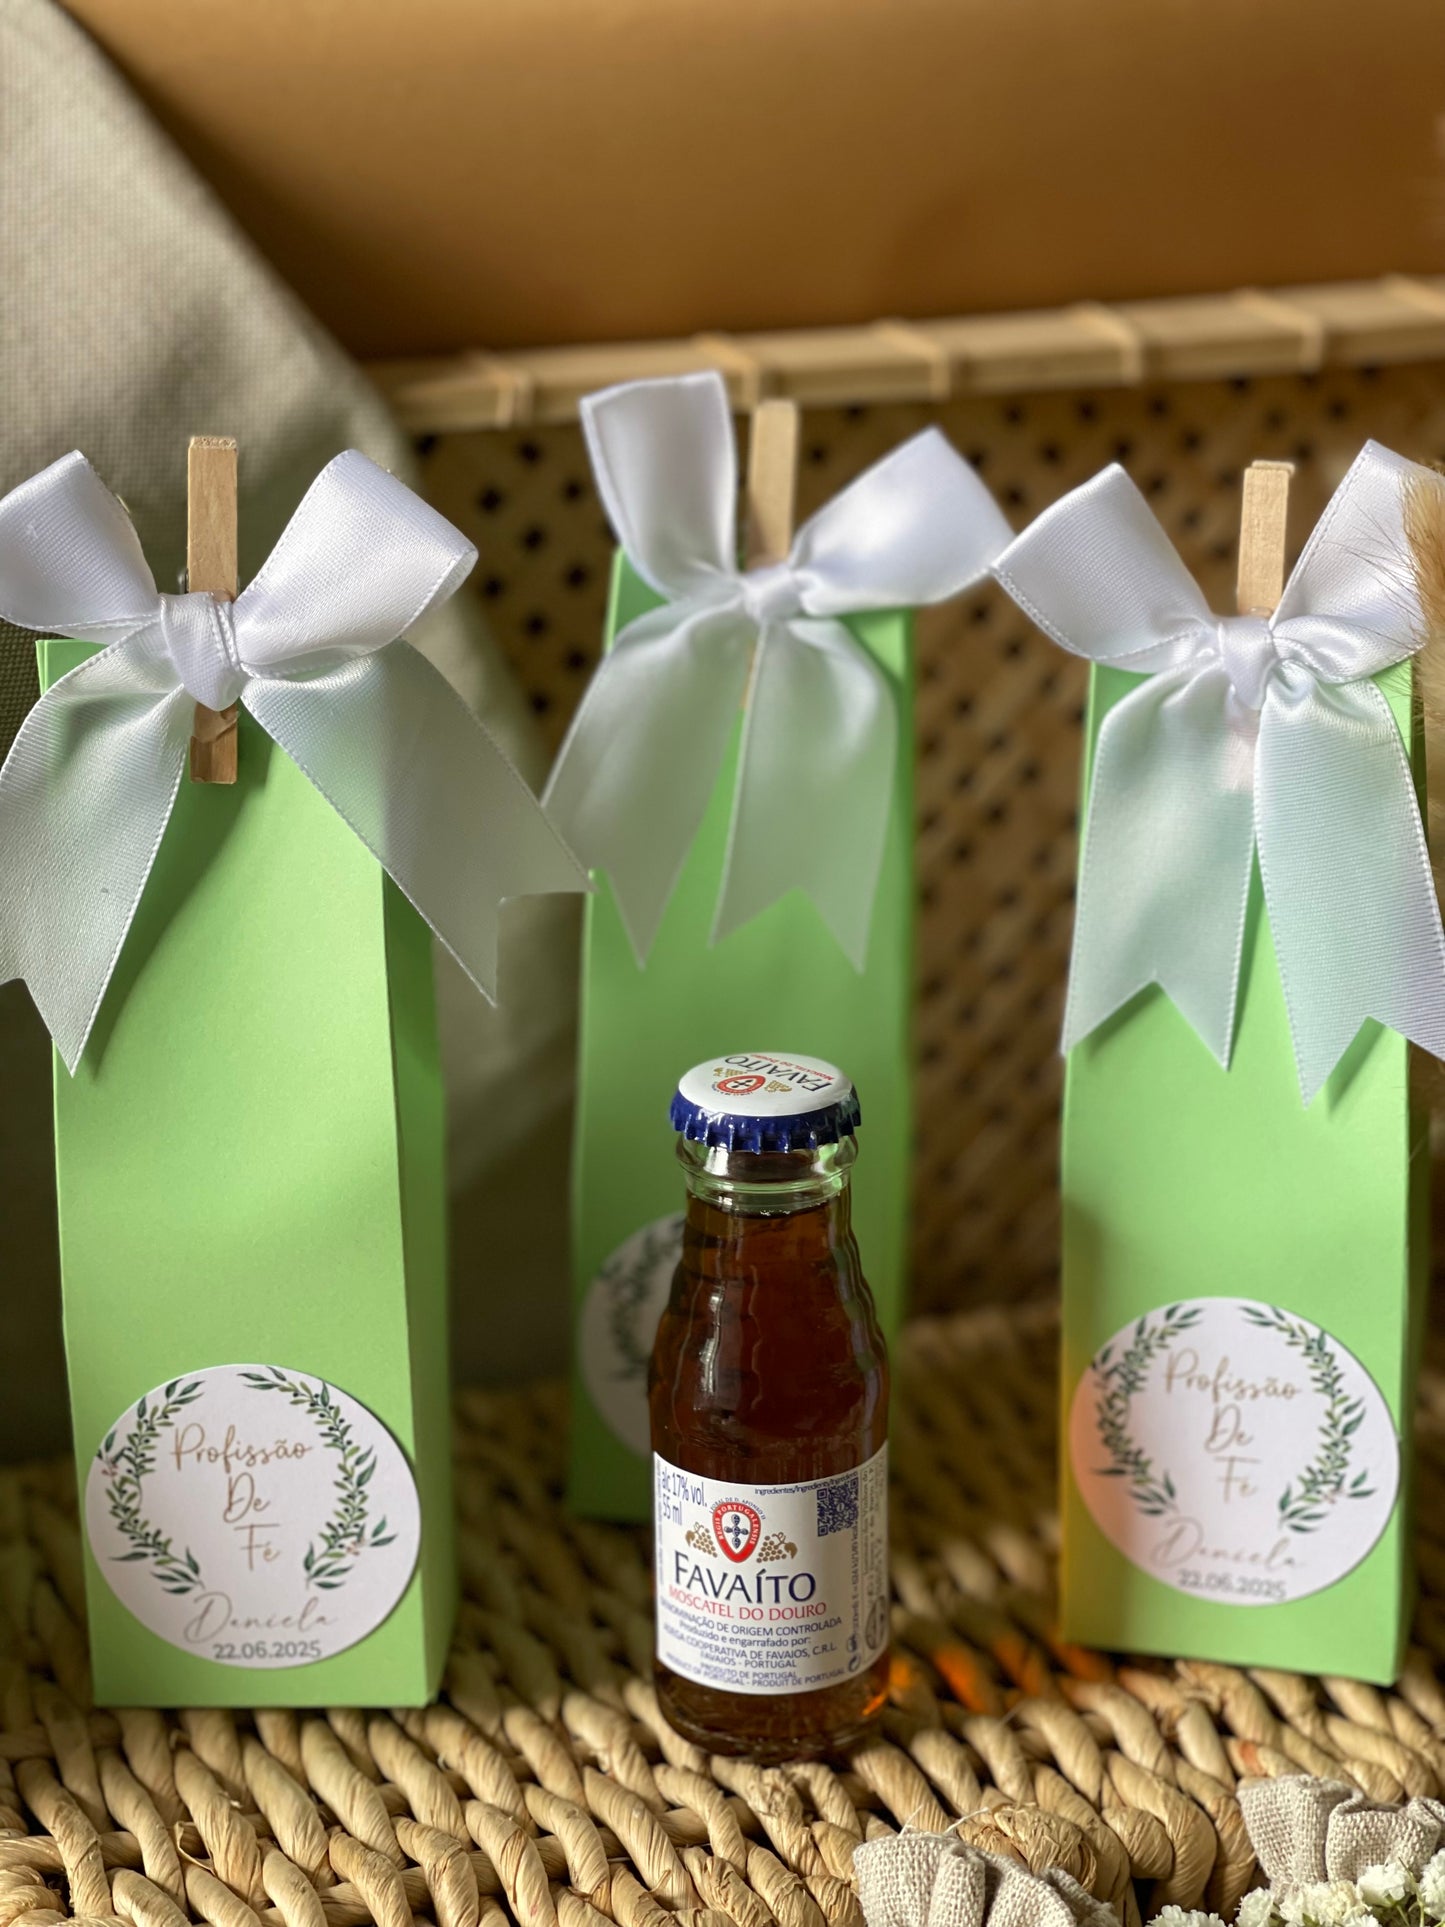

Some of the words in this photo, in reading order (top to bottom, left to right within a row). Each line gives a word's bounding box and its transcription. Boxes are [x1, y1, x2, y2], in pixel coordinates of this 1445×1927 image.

[724, 1055, 833, 1092] FAVAÍTO
[1161, 1348, 1303, 1403] Profissão
[1204, 1404, 1254, 1453] De
[170, 1422, 313, 1473] Profissão
[223, 1472, 271, 1523] De
[672, 1471, 690, 1501] 17%
[691, 1481, 708, 1507] vol.
[672, 1501, 683, 1526] ml
[233, 1523, 281, 1571] Fé
[674, 1549, 817, 1604] FAVAÍTO
[1178, 1569, 1288, 1600] 22.06.2025
[668, 1584, 735, 1619] MOSCATEL
[739, 1606, 764, 1621] DO
[768, 1602, 827, 1621] DOURO
[717, 1621, 730, 1633] DE
[731, 1624, 774, 1637] ORIGEM
[775, 1615, 843, 1637] CONTROLADA
[721, 1634, 728, 1644] e
[729, 1637, 789, 1648] engarrafado
[213, 1640, 322, 1660] 22.06.2025
[744, 1659, 798, 1669] PORTUGAL
[749, 1650, 764, 1660] DE
[752, 1671, 798, 1681] PORTUGAL
